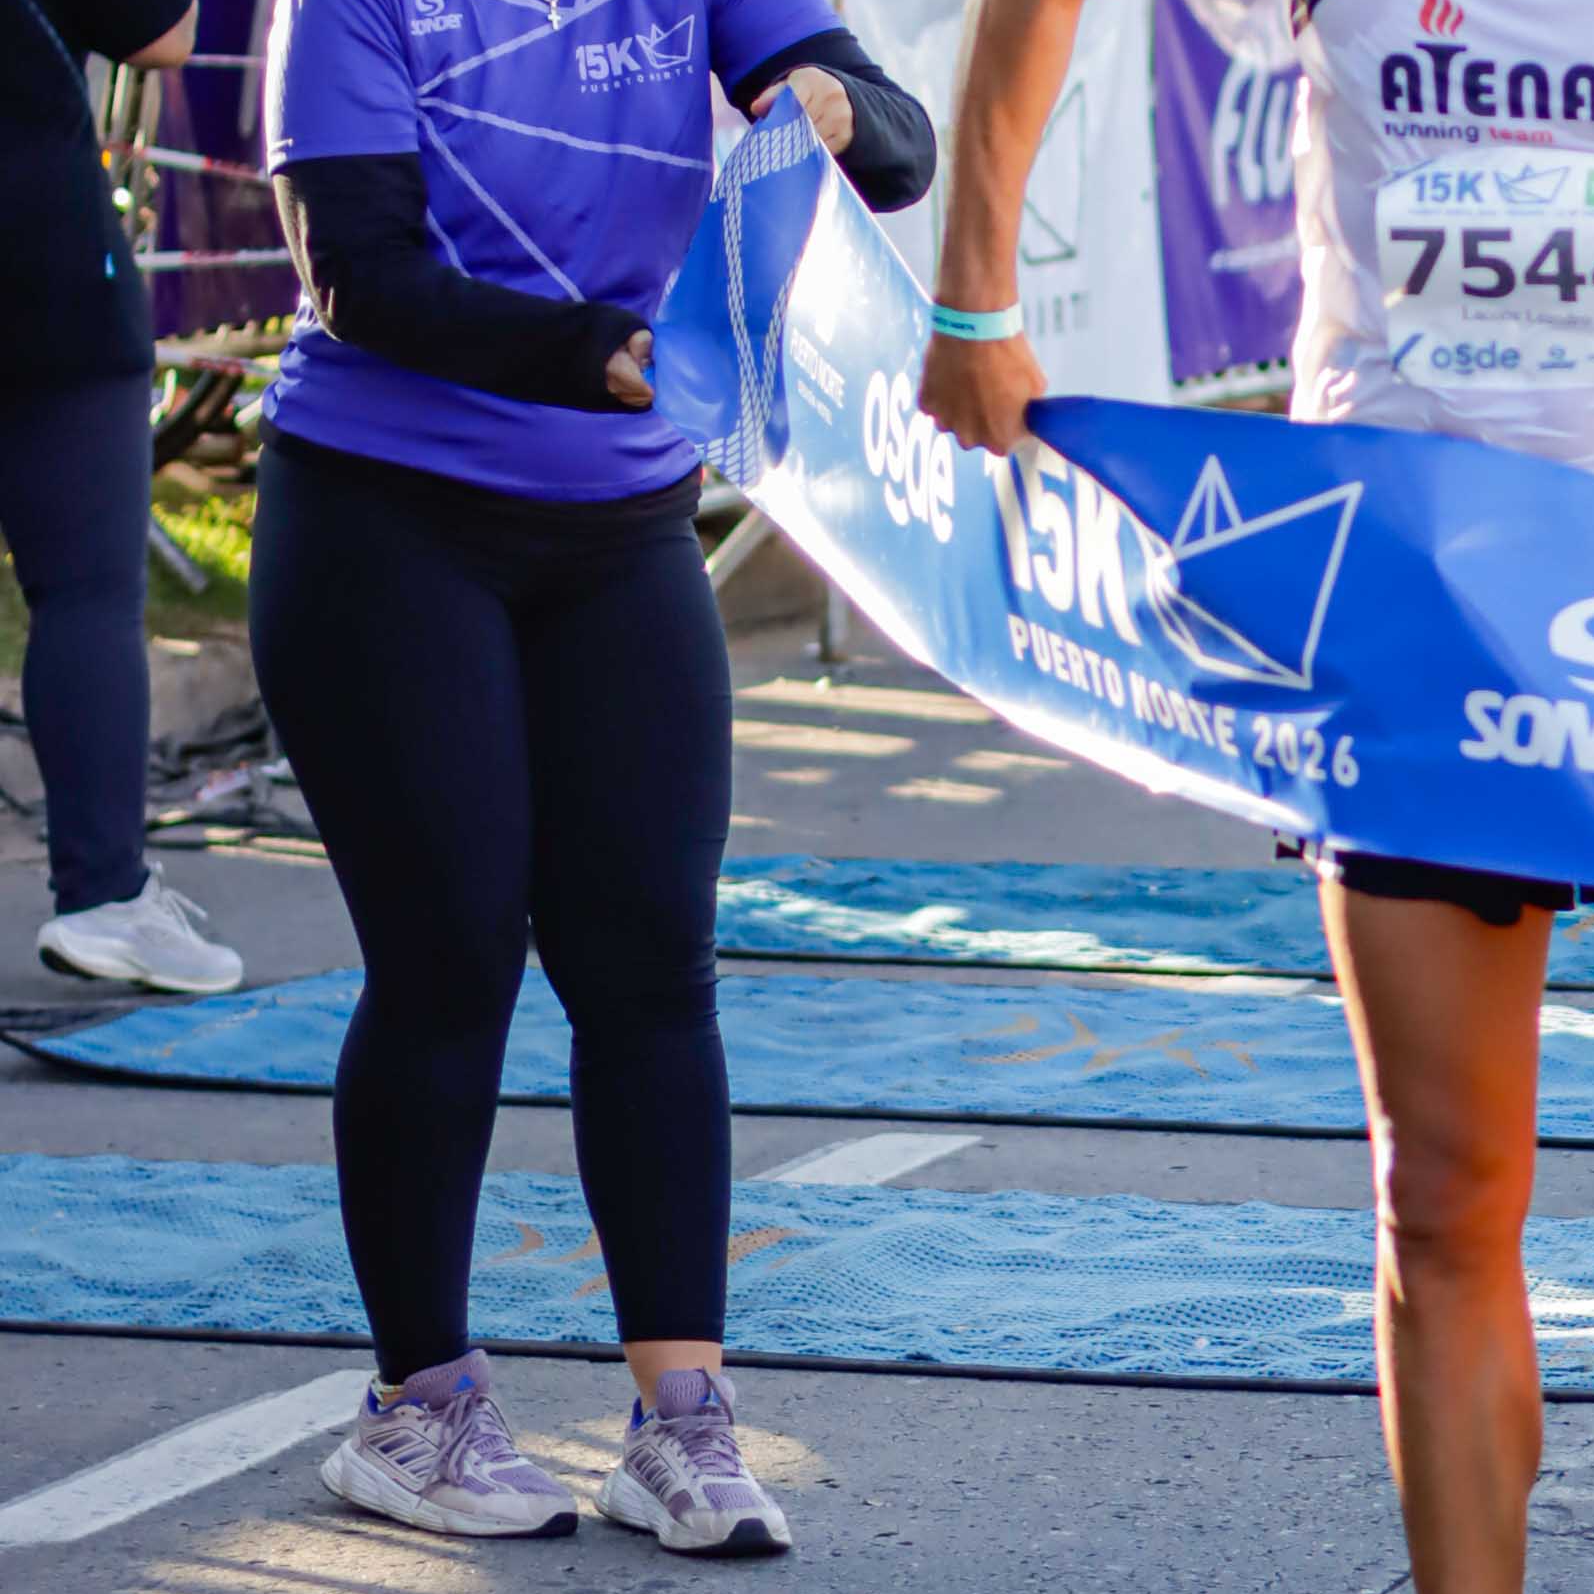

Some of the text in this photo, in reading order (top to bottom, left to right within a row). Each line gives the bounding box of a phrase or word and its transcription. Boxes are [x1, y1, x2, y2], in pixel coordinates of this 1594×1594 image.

[576, 37, 641, 81] 15K
[1384, 121, 1554, 145] running team
[1413, 170, 1484, 203] 15K
[1431, 341, 1521, 375] osde
[984, 441, 1142, 647] 15K
[1008, 613, 1361, 788] PUERTO NORTE 2026
